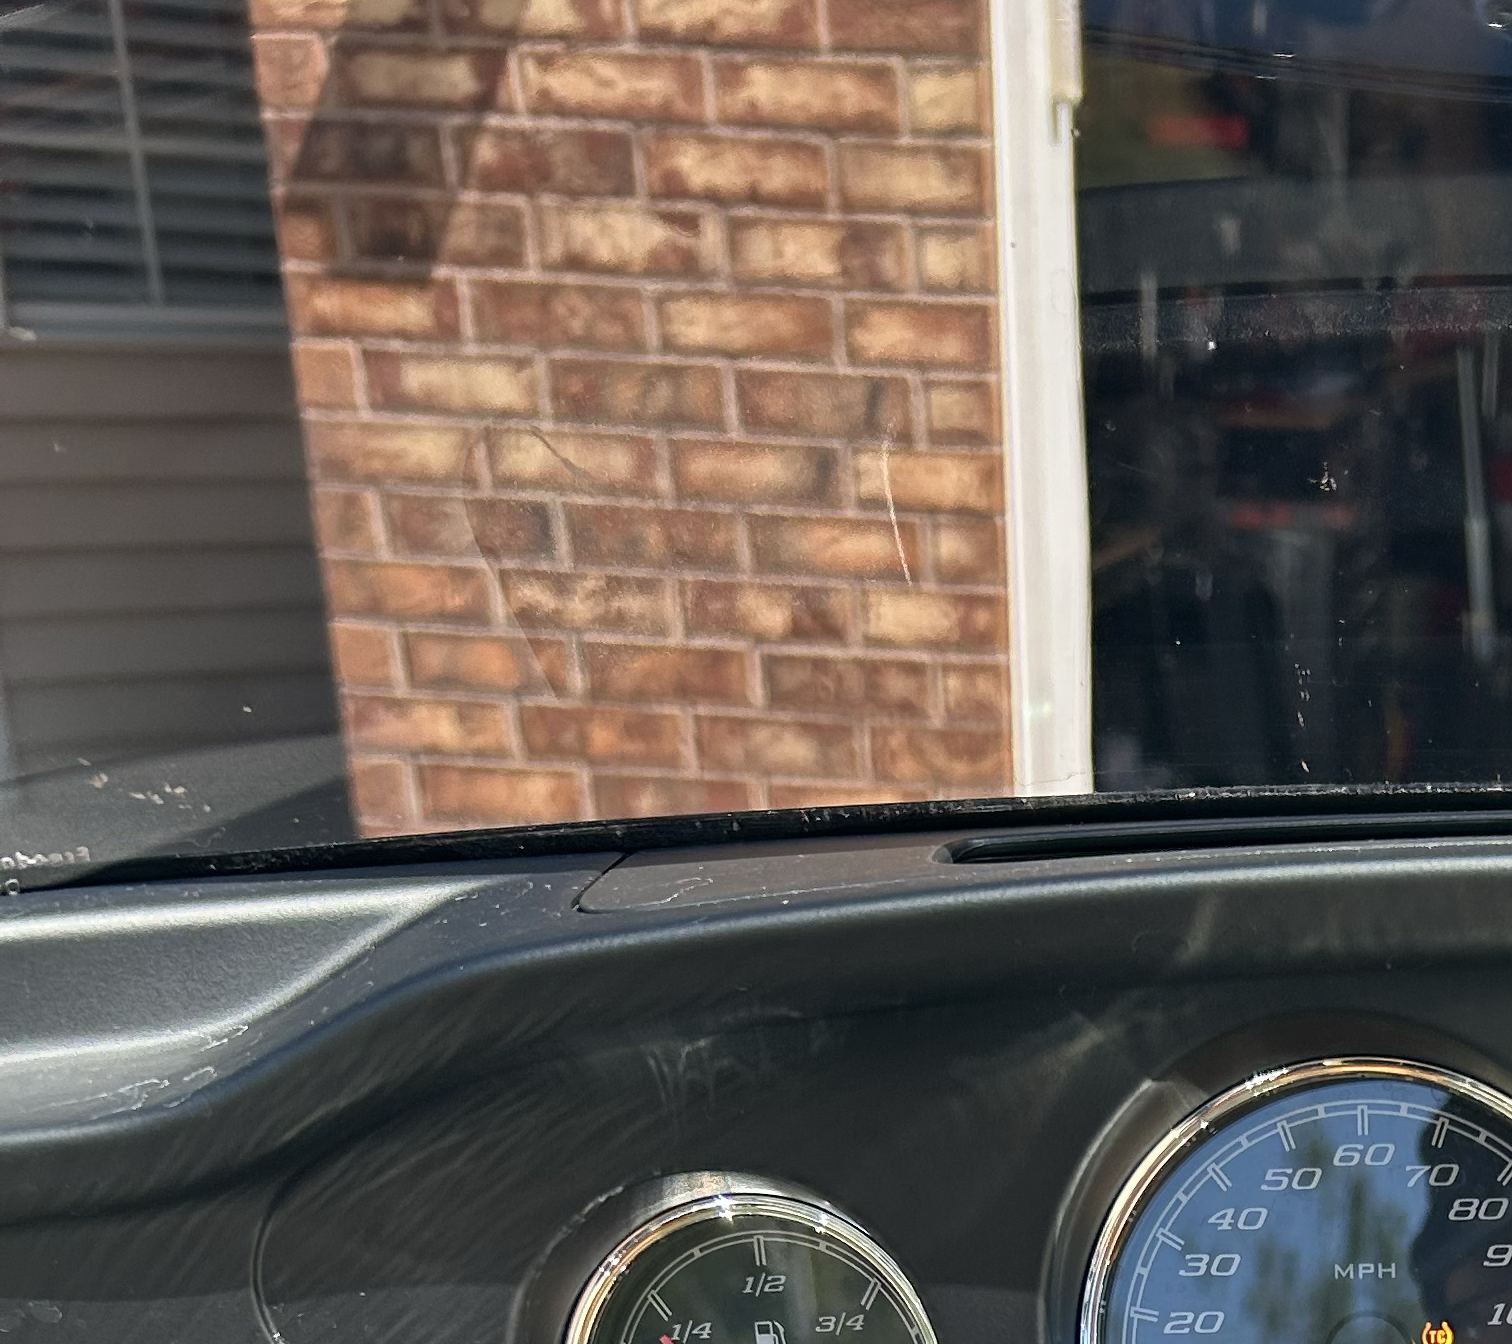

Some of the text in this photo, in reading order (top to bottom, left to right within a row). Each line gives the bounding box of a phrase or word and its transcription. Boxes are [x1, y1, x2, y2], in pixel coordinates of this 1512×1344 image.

[1333, 1143, 1396, 1167] 60
[1260, 1167, 1324, 1191] 50
[1405, 1164, 1460, 1188] 70
[1207, 1207, 1269, 1231] 40
[1448, 1197, 1510, 1222] 80
[1178, 1253, 1242, 1277] 30
[1334, 1263, 1397, 1280] MPH
[742, 1273, 786, 1297] 1/2
[671, 1320, 712, 1344] 1/4
[815, 1312, 865, 1336] 3/4
[1163, 1311, 1225, 1334] 20
[1428, 1329, 1447, 1344] TC
